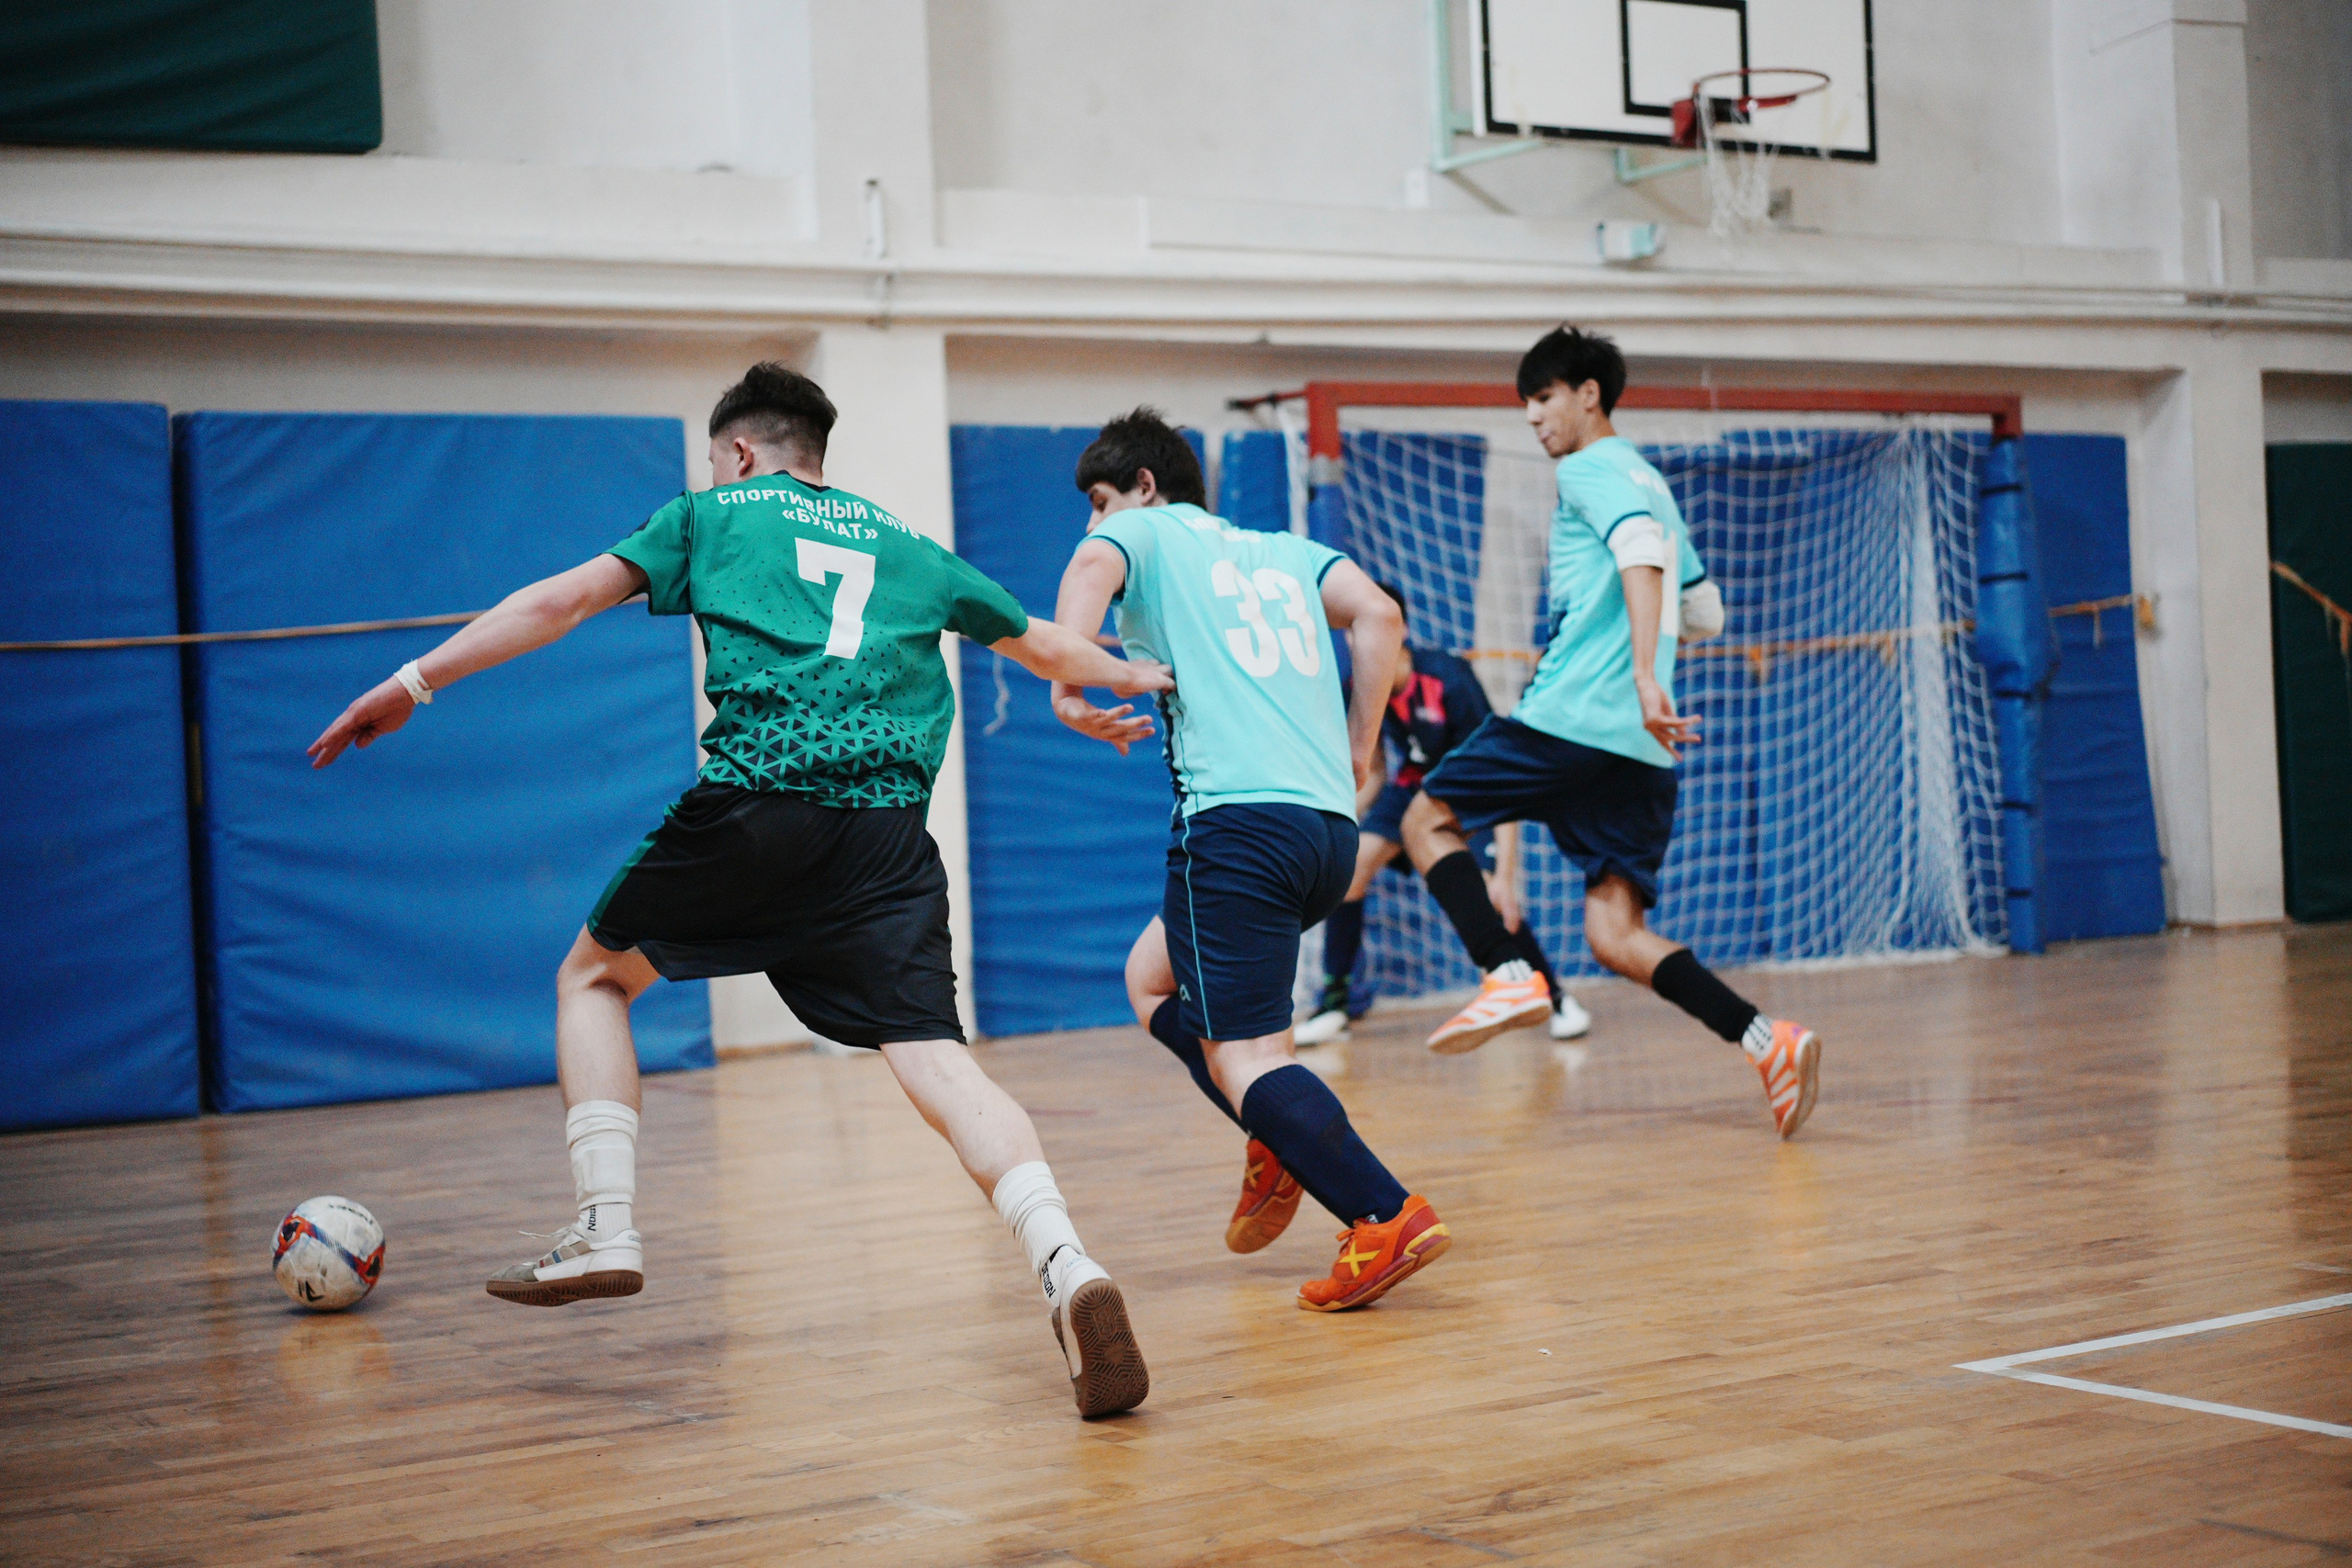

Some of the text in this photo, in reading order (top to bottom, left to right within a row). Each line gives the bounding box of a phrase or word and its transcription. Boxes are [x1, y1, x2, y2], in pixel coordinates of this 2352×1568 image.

[717, 489, 921, 540] СПОРТИВНЫЙ КЛУБ
[794, 536, 876, 660] 7
[1210, 559, 1321, 679] 33
[1041, 1262, 1057, 1298] DESIGN
